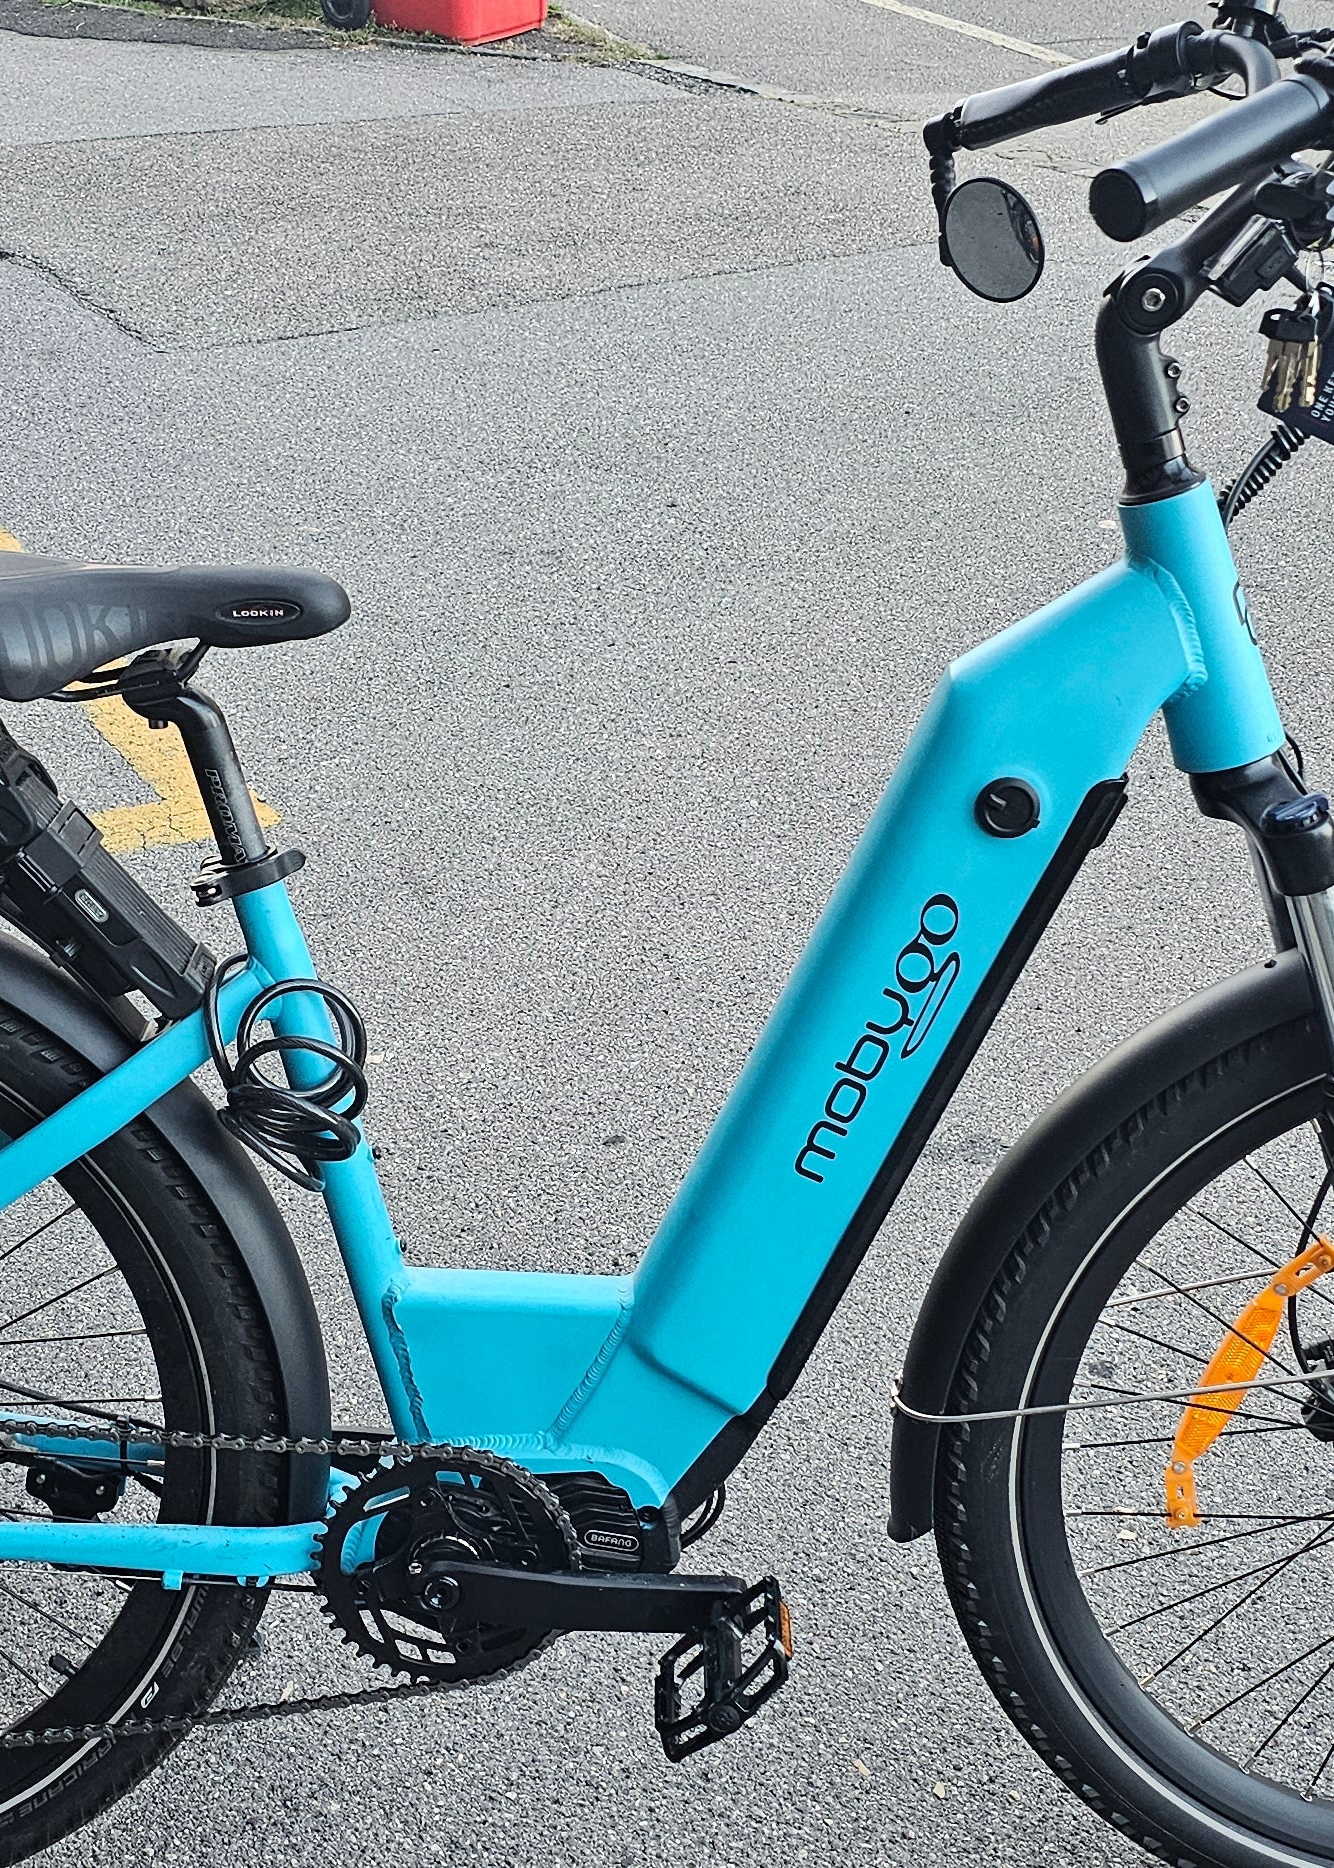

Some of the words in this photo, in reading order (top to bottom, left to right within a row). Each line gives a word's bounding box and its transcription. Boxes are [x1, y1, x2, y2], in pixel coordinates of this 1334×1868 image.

[1310, 395, 1329, 418] ONE
[231, 608, 285, 618] LOOKIN
[204, 768, 247, 864] PROMA
[794, 893, 961, 1184] mobygo
[161, 1584, 210, 1679] WALBE
[18, 1731, 117, 1818] RRICANE
